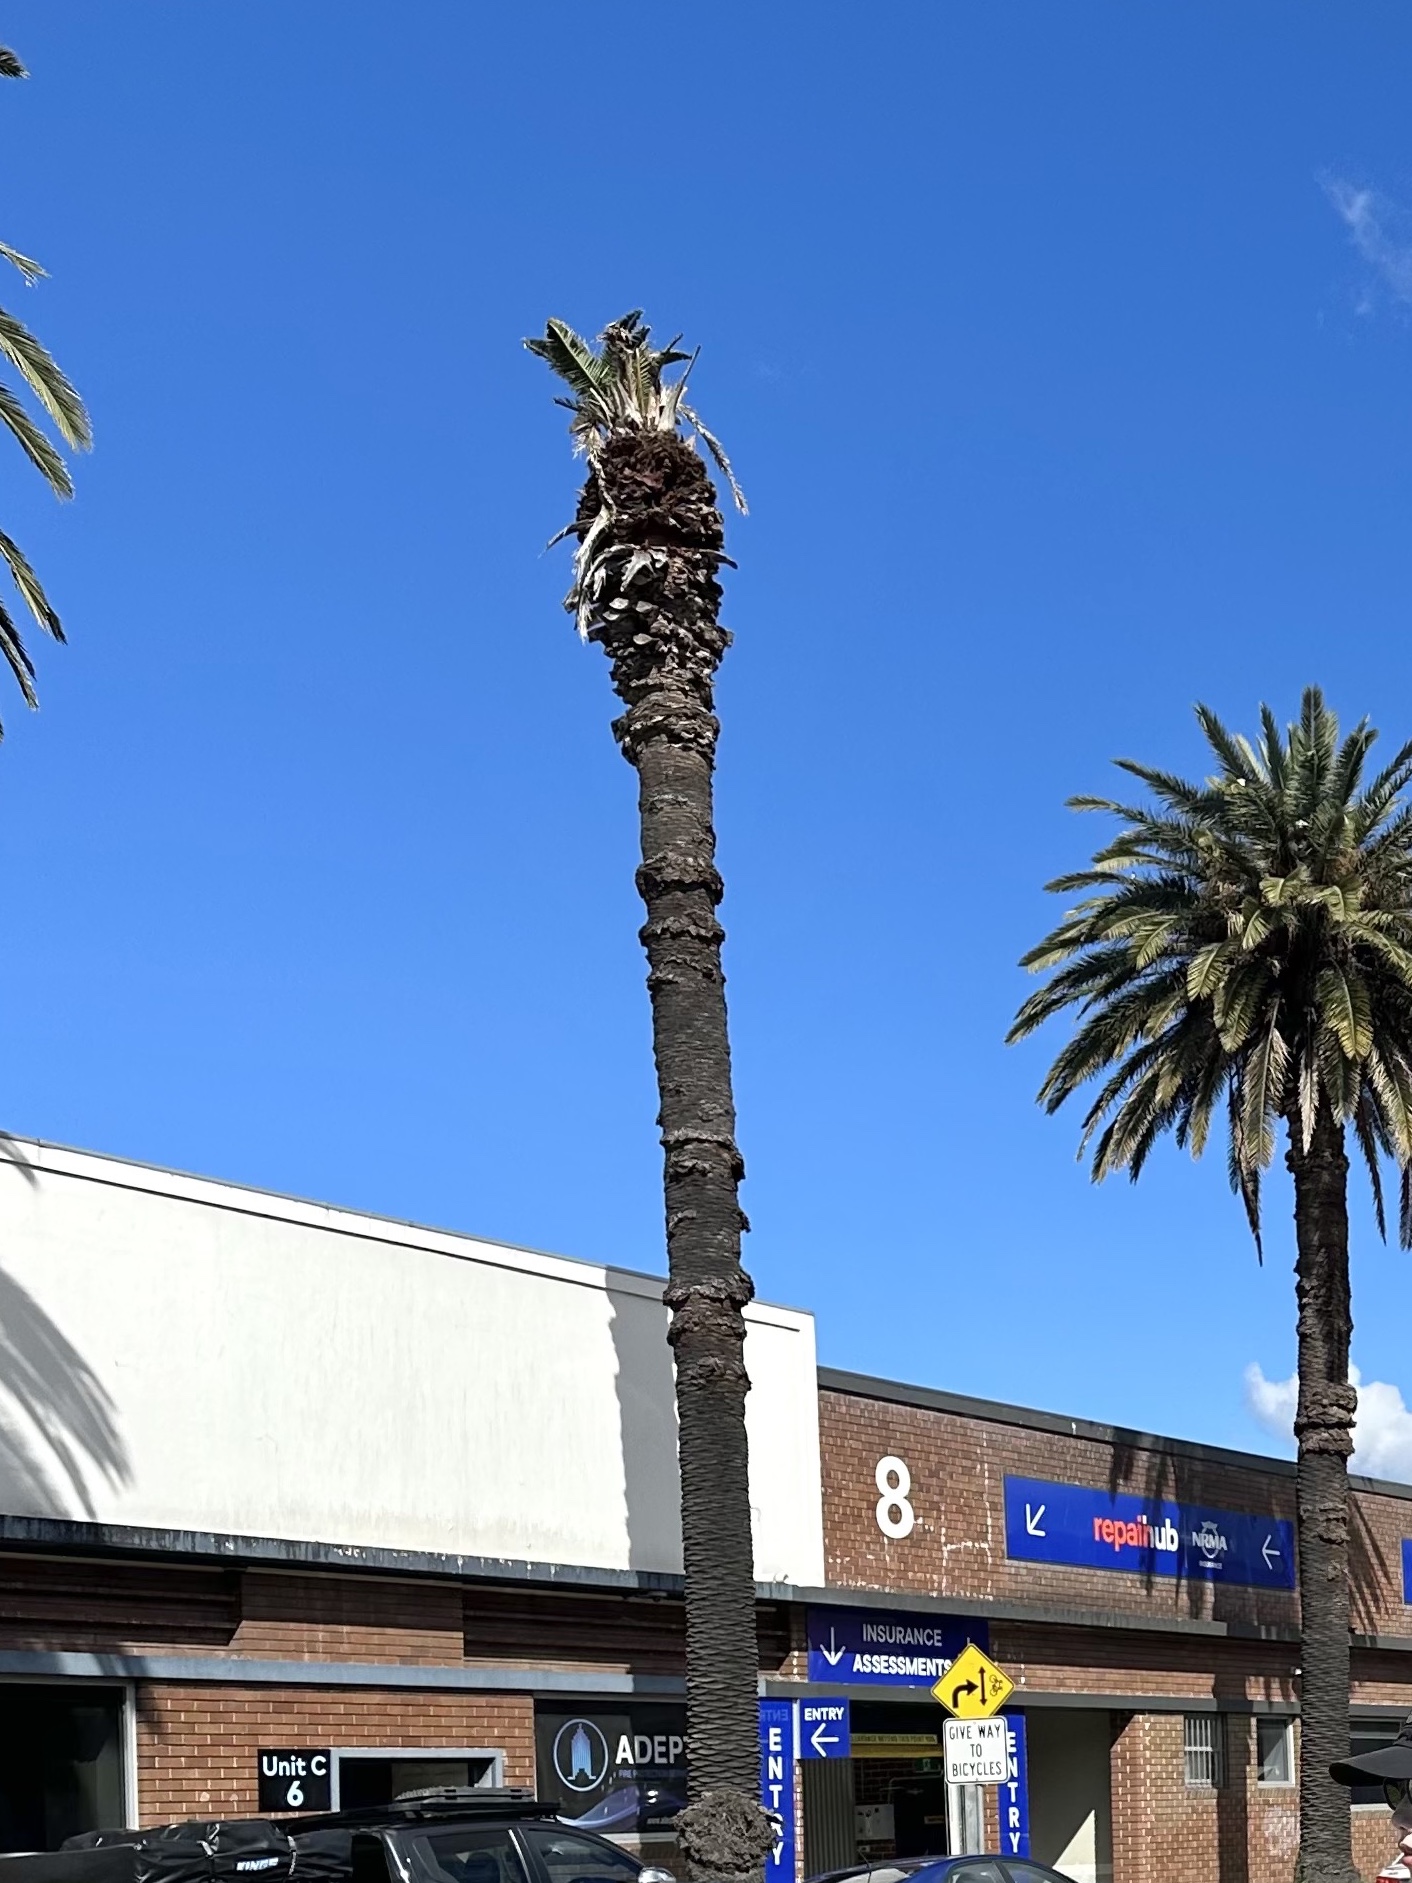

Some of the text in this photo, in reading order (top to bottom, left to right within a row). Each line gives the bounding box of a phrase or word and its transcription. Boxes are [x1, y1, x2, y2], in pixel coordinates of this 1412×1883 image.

[875, 1455, 914, 1539] 8
[1191, 1531, 1228, 1551] NRMA
[862, 1623, 942, 1647] INSURANCE
[852, 1653, 952, 1677] ASSESSMENTS
[804, 1707, 844, 1721] ENTRY
[949, 1725, 972, 1740] GIVE
[977, 1724, 1001, 1739] WAY
[615, 1735, 687, 1765] ADEP
[970, 1743, 982, 1758] TO
[262, 1755, 327, 1776] Unit C
[952, 1761, 1002, 1777] BICYCLES
[287, 1780, 304, 1807] 6
